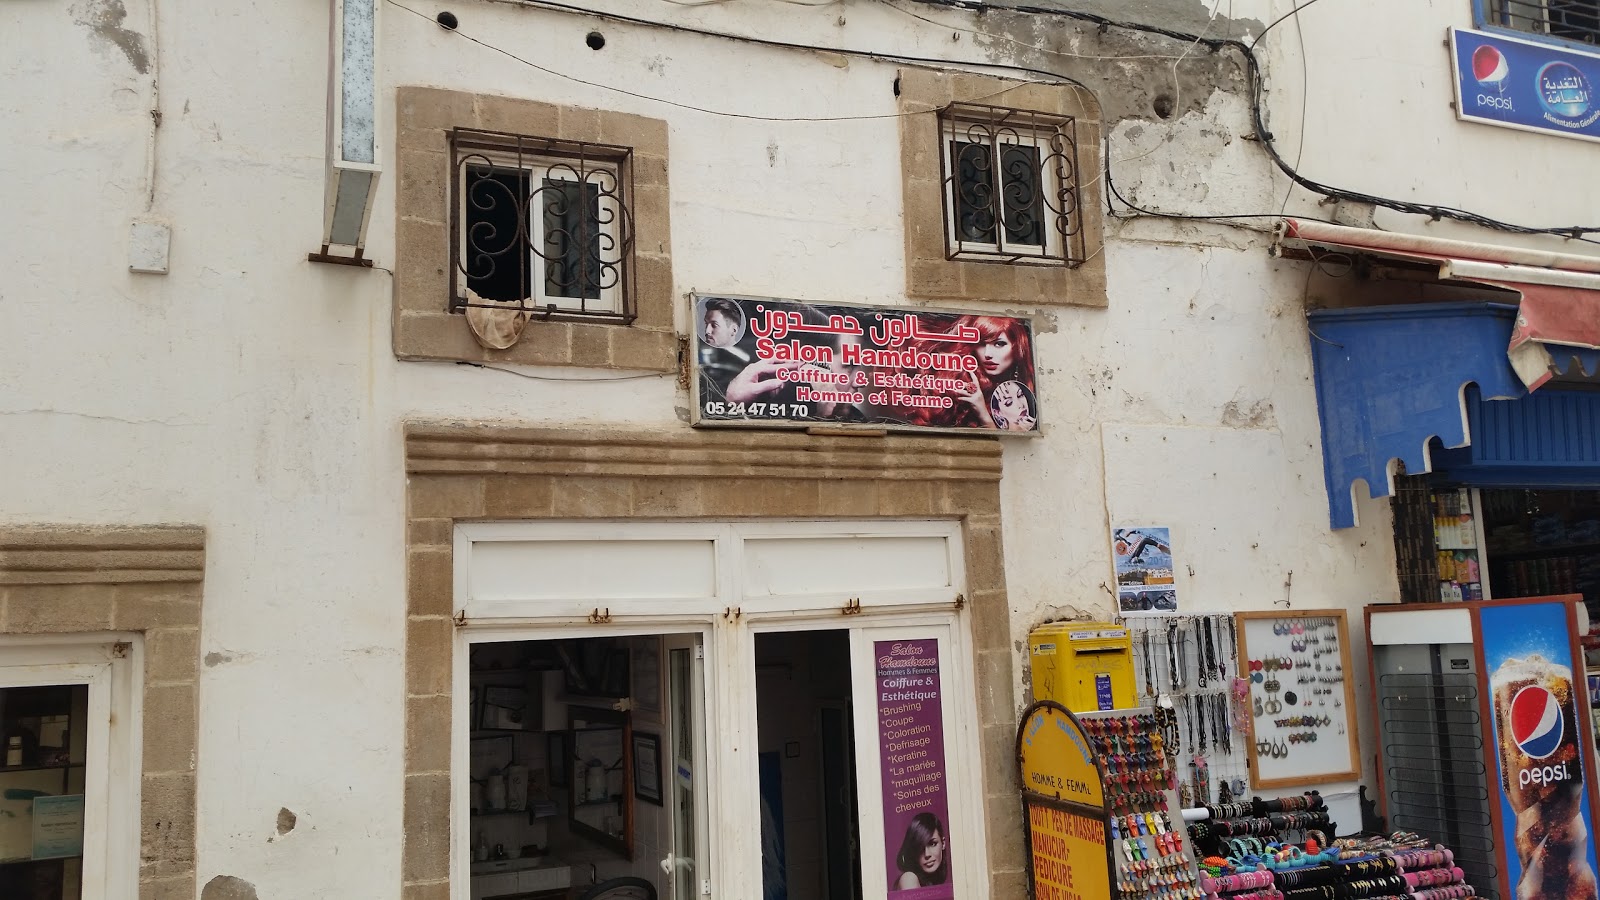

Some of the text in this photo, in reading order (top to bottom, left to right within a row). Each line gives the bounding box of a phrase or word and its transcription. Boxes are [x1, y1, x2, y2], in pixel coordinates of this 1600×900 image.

[1477, 94, 1513, 110] pepsi
[1544, 112, 1580, 128] Alimentation
[756, 338, 978, 373] Salon Hamdoune
[776, 367, 965, 394] Coiffure & Esthétique
[796, 386, 953, 410] Homme et Femme
[706, 401, 809, 418] 05 24 47 51 70
[890, 643, 924, 656] Salon
[878, 656, 937, 669] Hamdoune
[882, 676, 934, 689] Coiffure &
[882, 690, 937, 701] Esthétique
[906, 760, 936, 773] mariée
[1031, 772, 1056, 788] HOMME
[1057, 778, 1063, 789] &
[1519, 760, 1568, 790] pepsi
[923, 784, 940, 794] des
[895, 798, 932, 813] cheveux
[1044, 806, 1063, 833] TPES
[1063, 811, 1073, 836] DE
[1073, 814, 1105, 846] MASSAGE
[1034, 854, 1074, 889] PEDICURE
